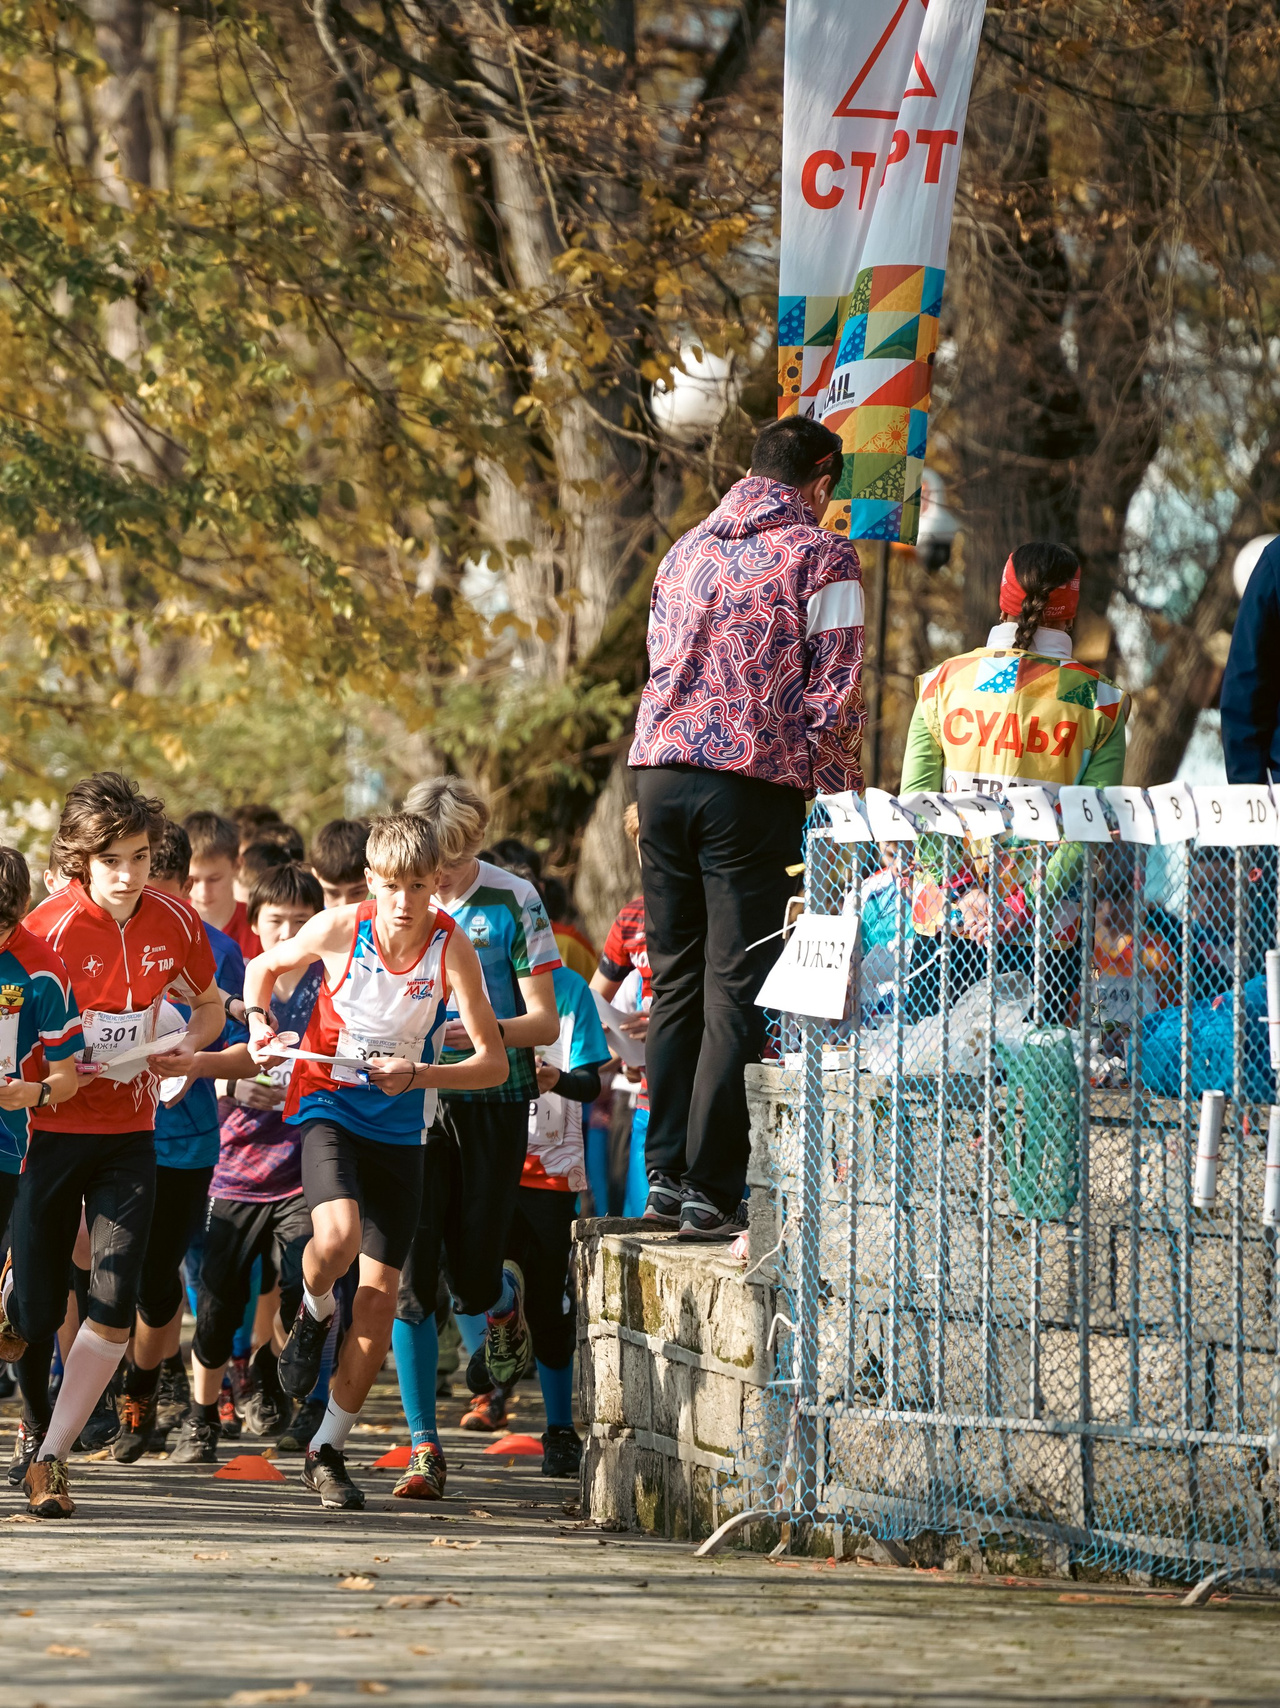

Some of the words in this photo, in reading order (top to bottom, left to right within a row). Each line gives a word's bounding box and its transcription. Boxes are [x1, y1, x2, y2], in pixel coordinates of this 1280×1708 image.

[801, 129, 958, 210] СТРТ
[943, 708, 1078, 758] СУДЬЯ
[922, 799, 941, 816] 3
[970, 801, 987, 816] 4
[1025, 799, 1039, 821] 5
[1082, 799, 1093, 823] 6
[1124, 799, 1136, 822] 7
[1170, 796, 1183, 820] 8
[1211, 800, 1222, 824] 9
[1246, 799, 1267, 823] 10
[100, 1026, 137, 1042] 301
[530, 1101, 538, 1116] 9
[546, 1110, 550, 1120] 1
